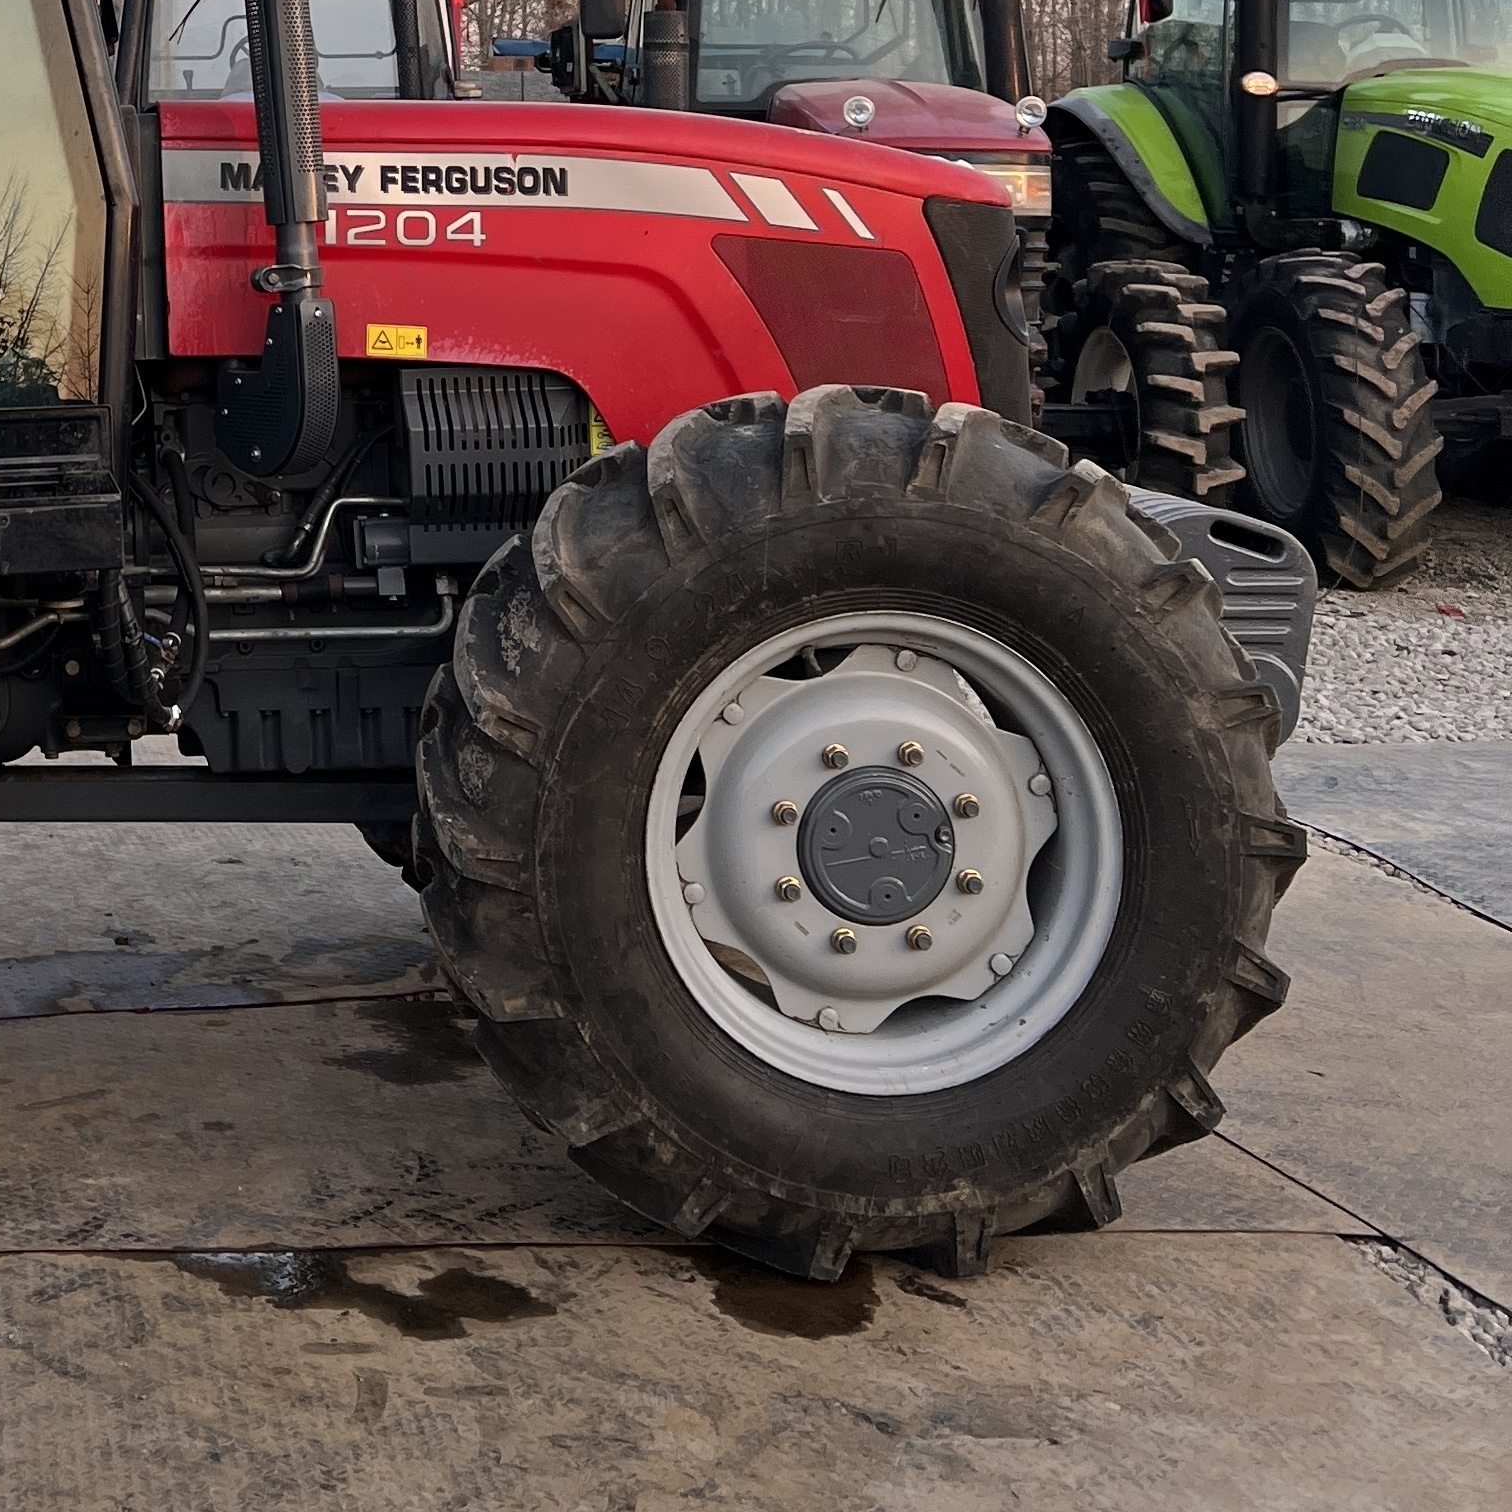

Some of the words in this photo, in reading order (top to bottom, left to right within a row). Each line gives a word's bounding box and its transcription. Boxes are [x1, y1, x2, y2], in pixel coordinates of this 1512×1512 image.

[220, 162, 365, 193] MEY
[380, 165, 569, 197] FERGUSON
[325, 208, 487, 247] 1204
